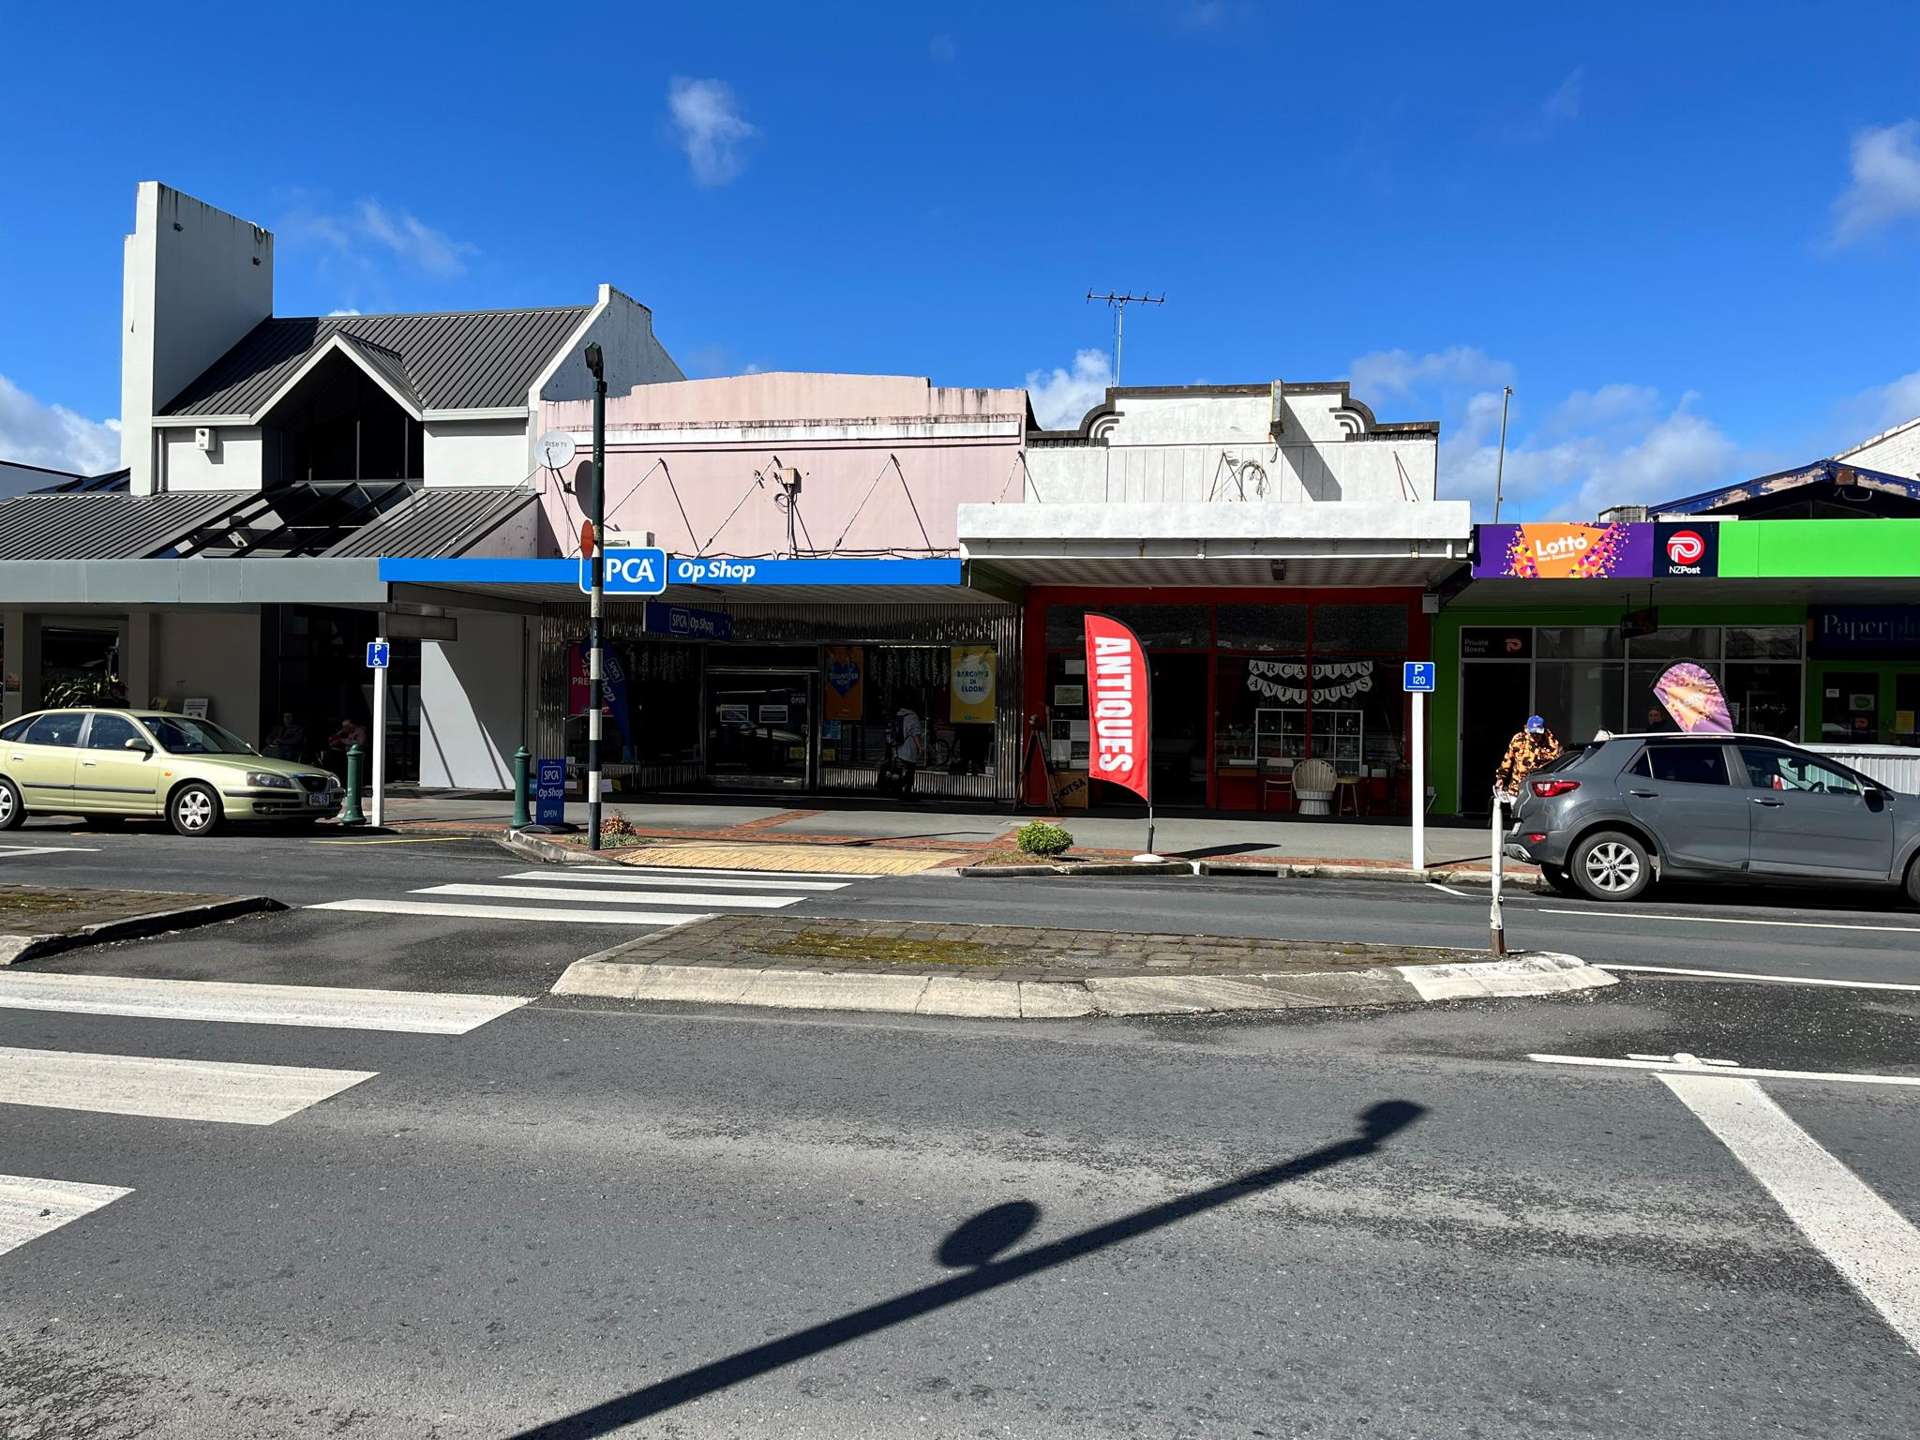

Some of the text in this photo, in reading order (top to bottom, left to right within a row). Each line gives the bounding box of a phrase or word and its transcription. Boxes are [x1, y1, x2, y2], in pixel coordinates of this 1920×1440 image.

[1535, 536, 1588, 556] Lotto
[606, 558, 656, 584] PCA
[678, 560, 756, 583] Op Shop
[672, 614, 688, 629] SPCA
[374, 644, 382, 653] P
[1251, 661, 1371, 676] ARCADIAN
[1415, 664, 1424, 675] P
[1412, 676, 1426, 685] 120
[1250, 677, 1370, 700] ANTIQUES
[1094, 636, 1134, 773] ANTIQUES
[543, 769, 560, 781] SPCA
[538, 788, 547, 800] Op
[547, 786, 564, 800] Shop
[543, 809, 558, 818] OPEN
